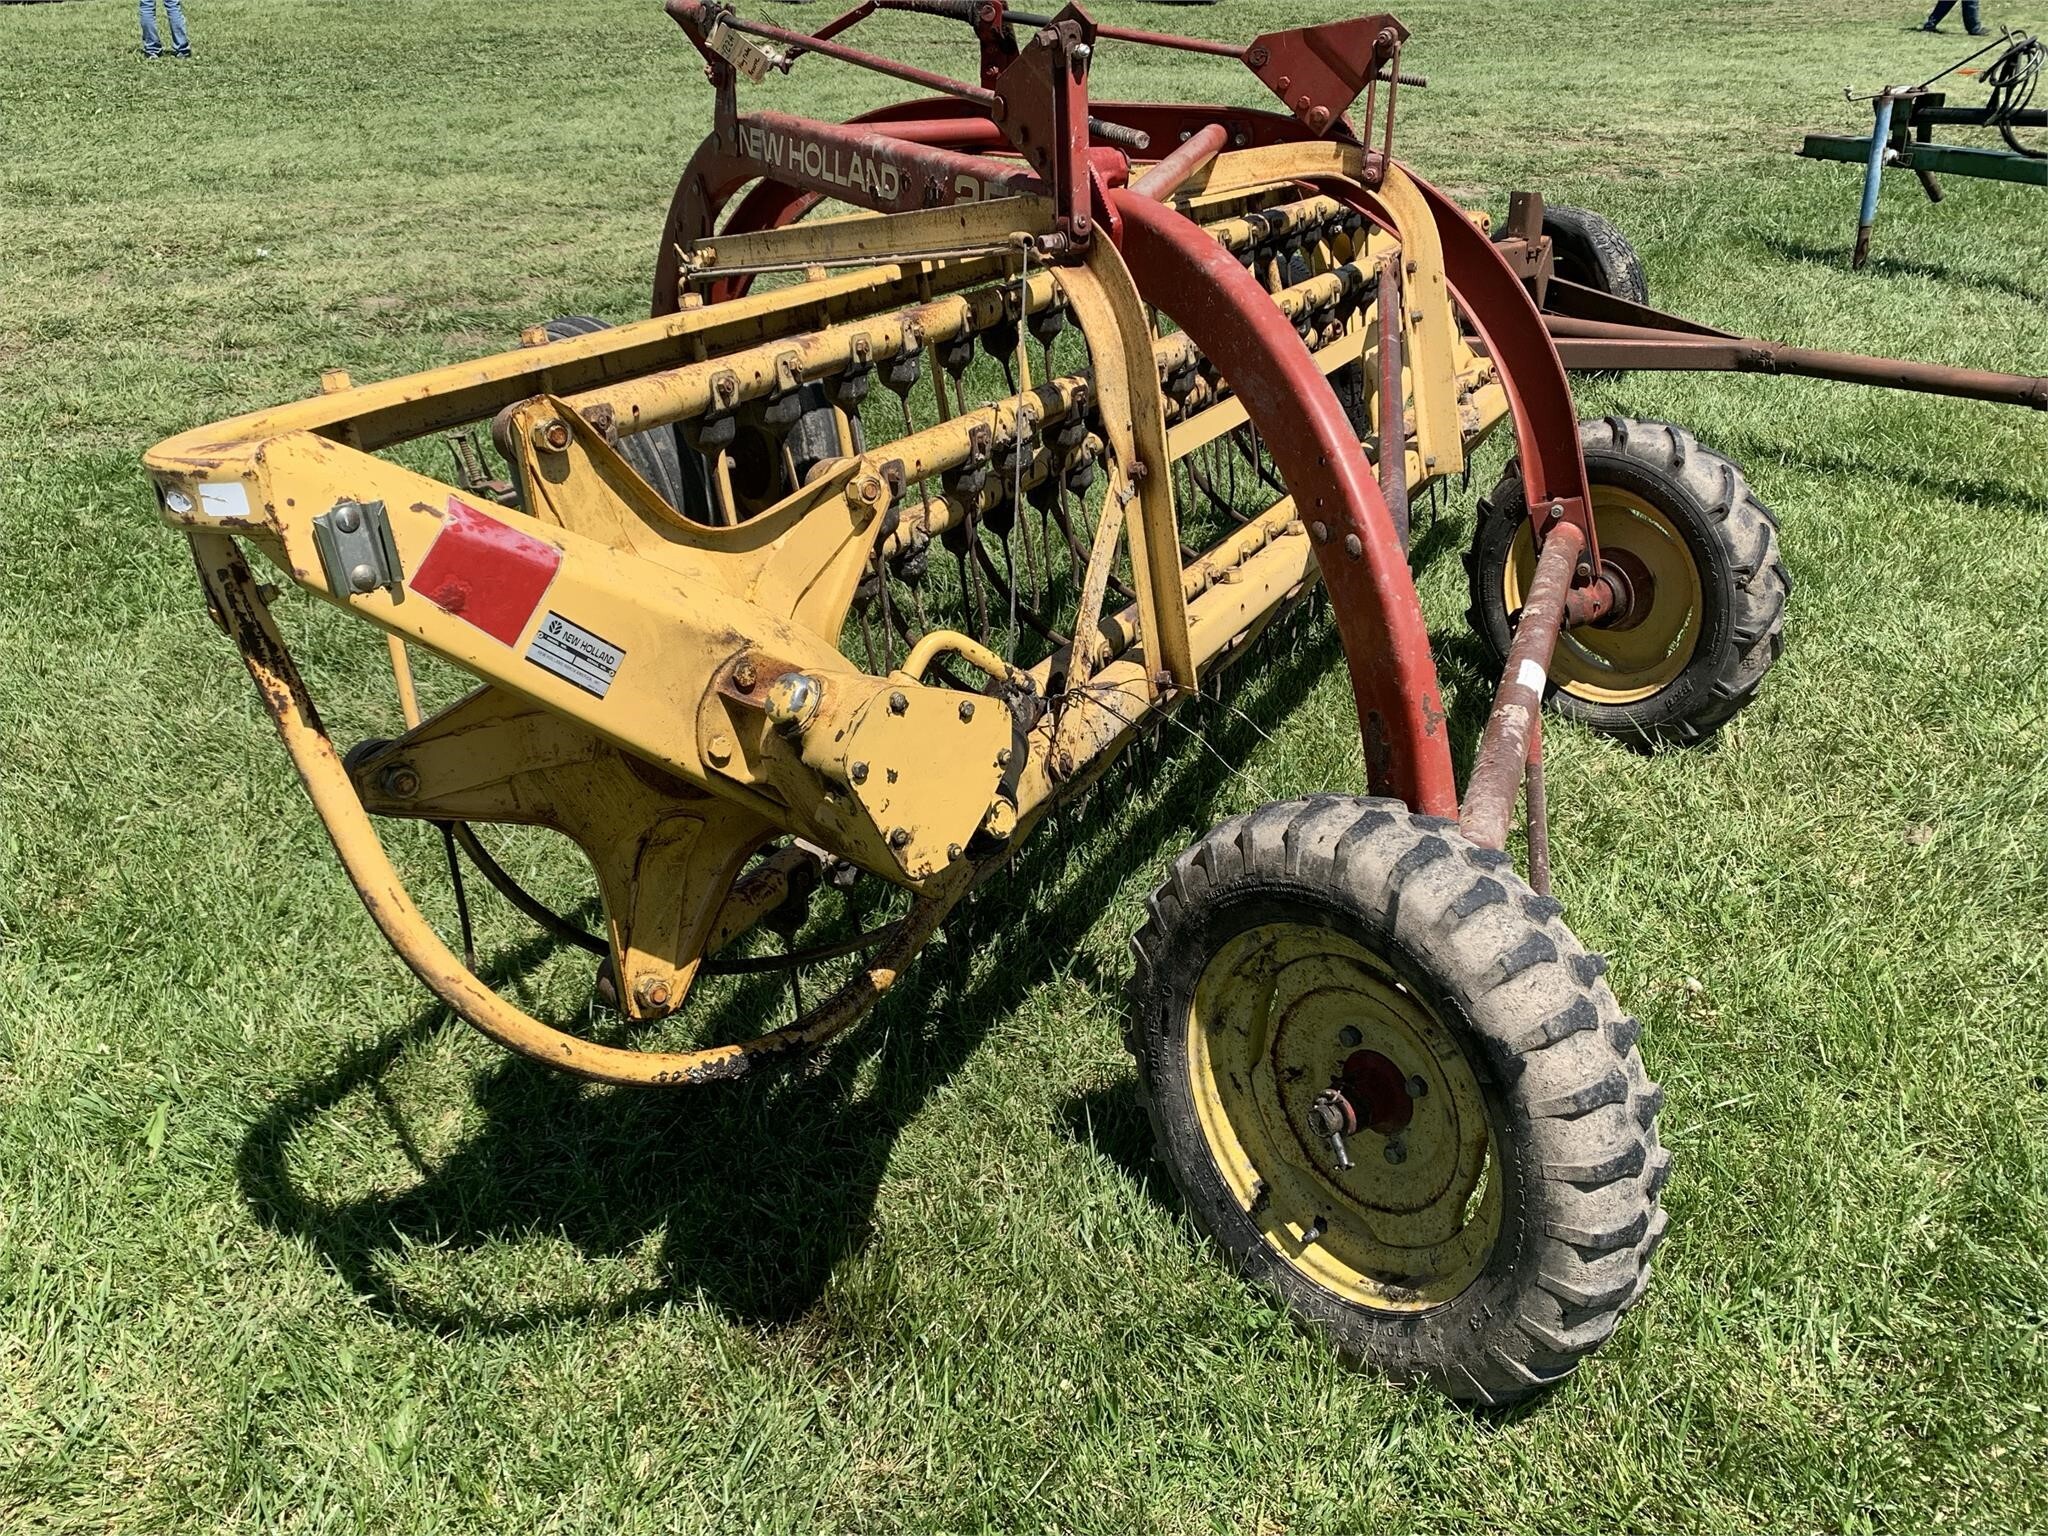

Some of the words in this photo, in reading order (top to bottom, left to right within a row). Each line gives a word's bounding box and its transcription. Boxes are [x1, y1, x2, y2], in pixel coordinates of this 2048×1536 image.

[738, 124, 784, 167] NEW
[788, 137, 899, 200] HOLLAND
[562, 631, 581, 647] NEW
[580, 641, 615, 665] HOLLAND
